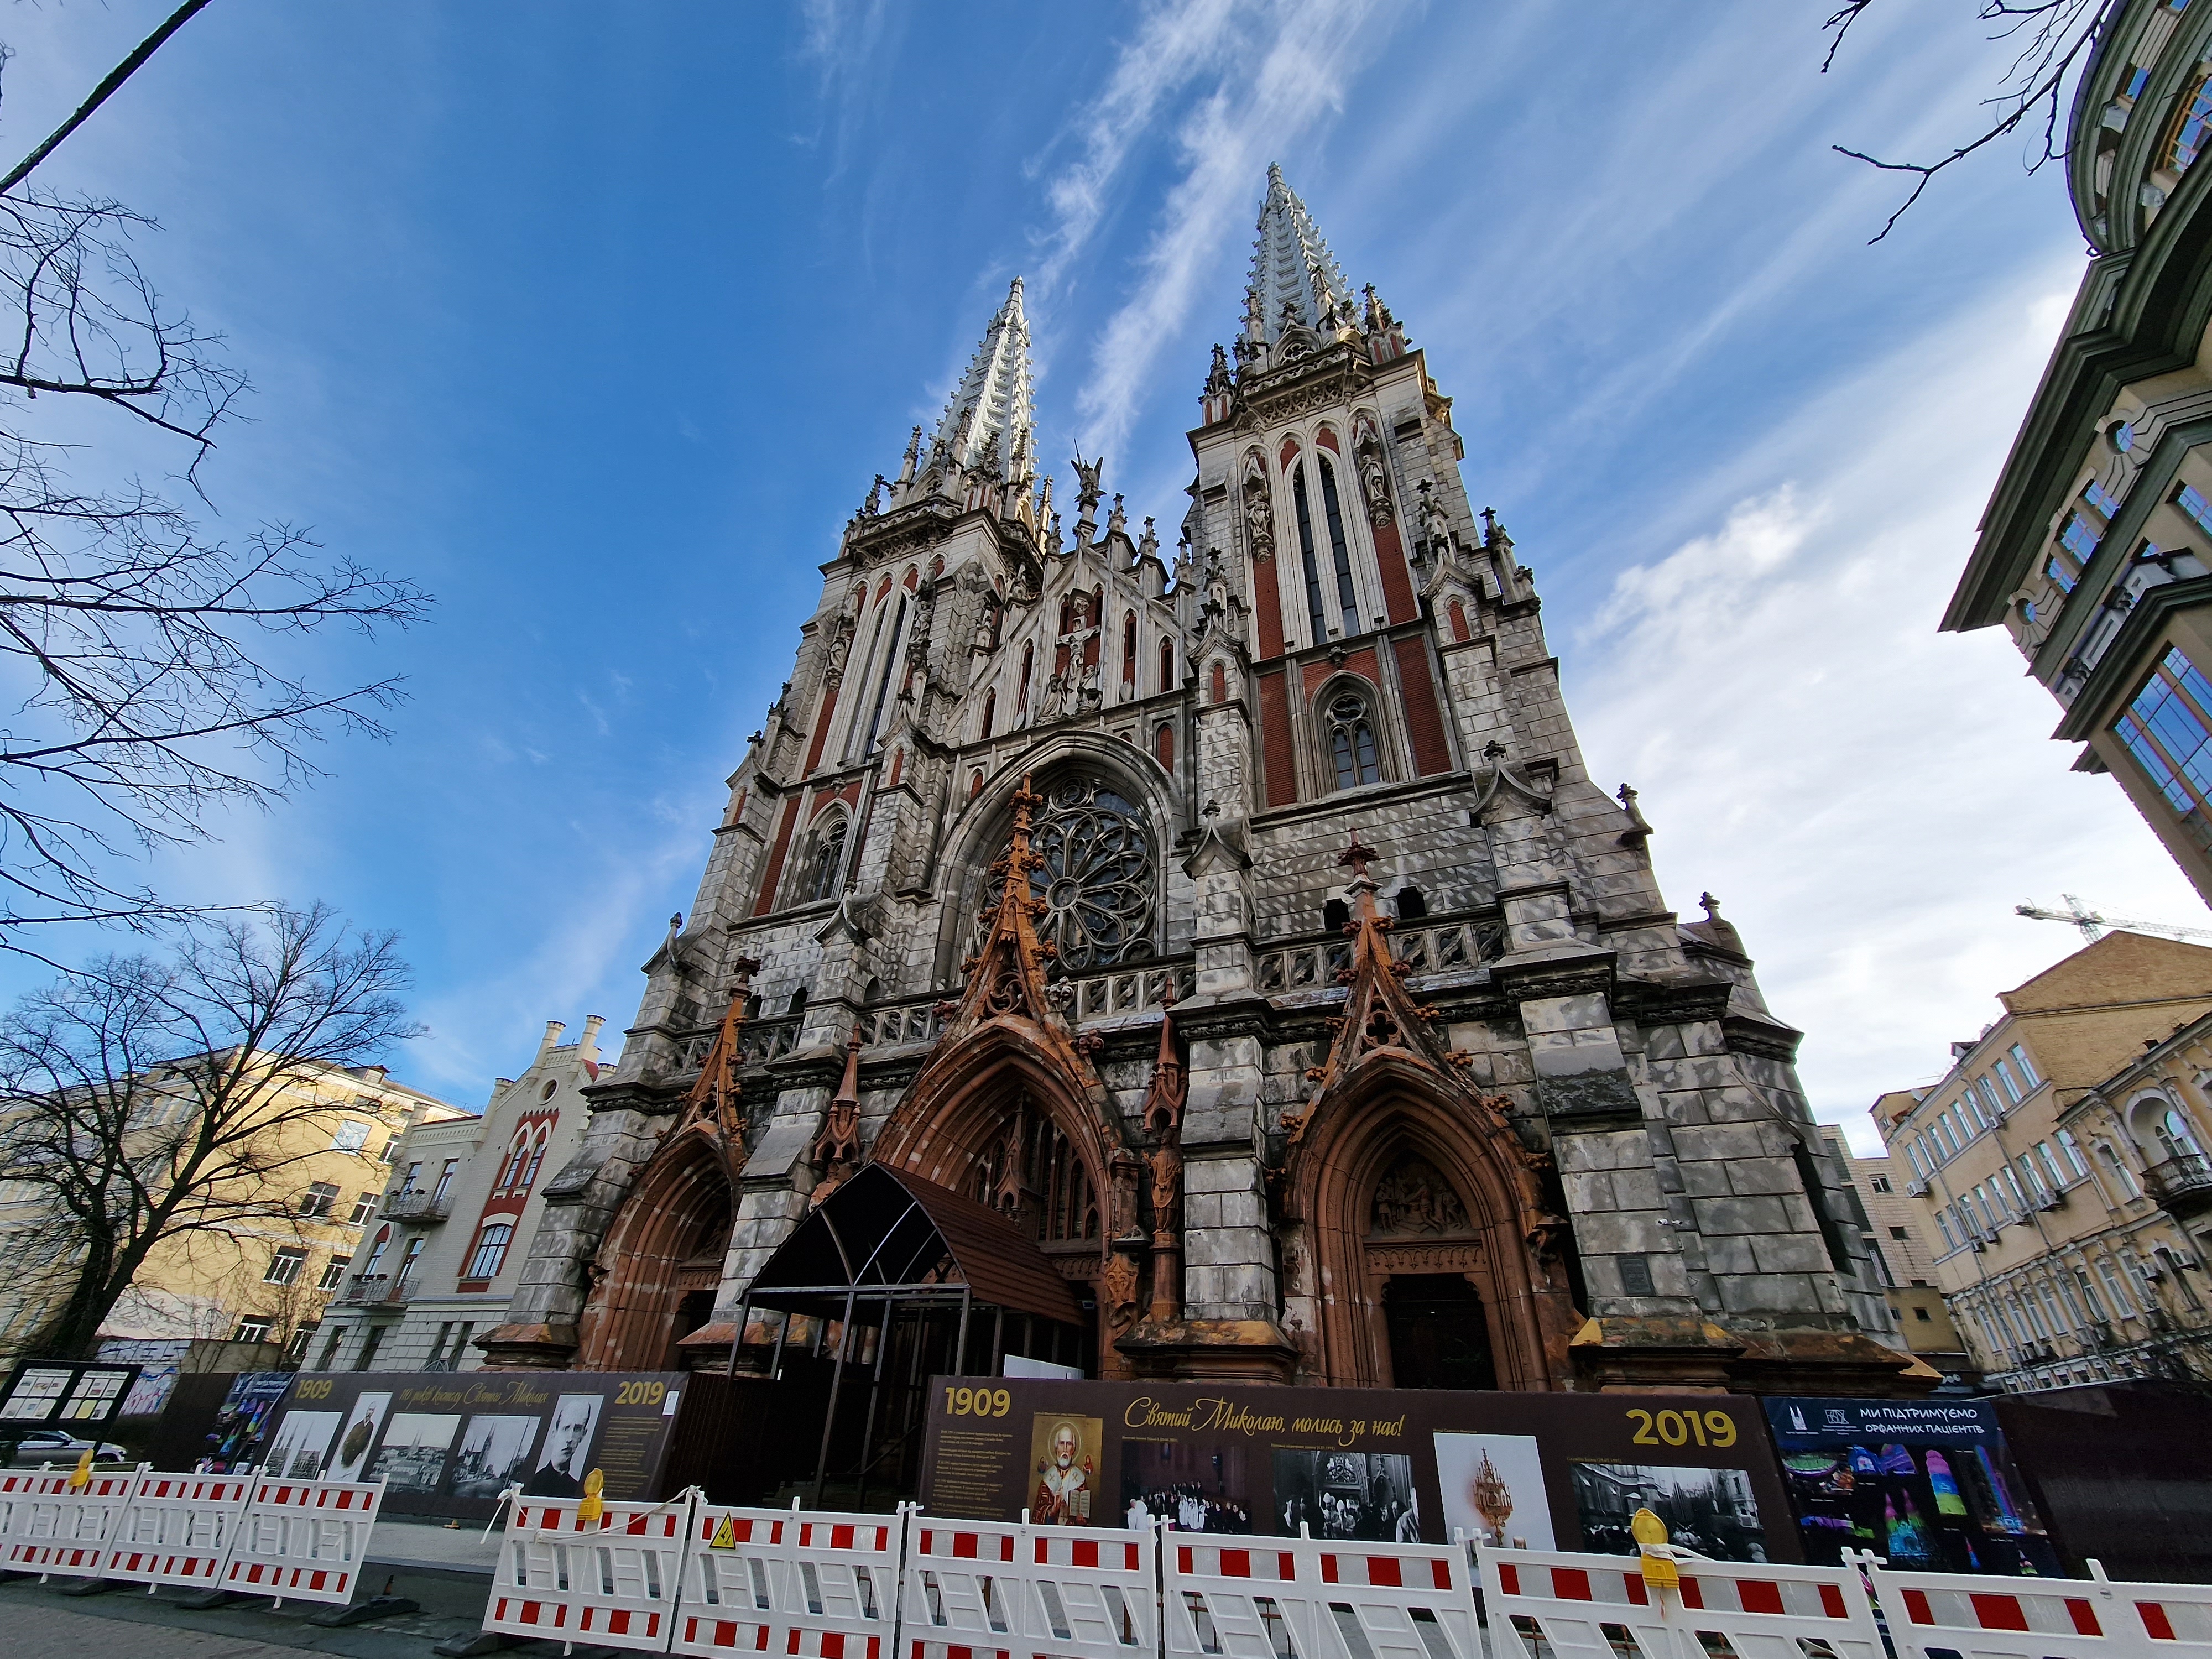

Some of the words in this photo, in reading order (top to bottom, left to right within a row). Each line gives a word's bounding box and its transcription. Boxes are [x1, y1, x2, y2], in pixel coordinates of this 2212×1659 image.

[295, 1379, 332, 1399] 1909
[463, 1382, 502, 1405] Святого
[499, 1380, 549, 1407] Миколая
[614, 1381, 664, 1405] 2019
[945, 1387, 1011, 1417] 1909
[1124, 1397, 1194, 1427] Святий
[1192, 1396, 1286, 1436] Миколаю,
[1291, 1417, 1343, 1434] молись
[1338, 1420, 1366, 1447] за
[1372, 1413, 1405, 1437] нас!
[1625, 1408, 1737, 1447] 2019
[1859, 1408, 1881, 1418] МИ
[1882, 1408, 1978, 1423] ПІДТРИМУЄМО
[1865, 1424, 1925, 1434] ОРФАННИХ
[1926, 1425, 1985, 1435] ПАЦІЄНТІВ
